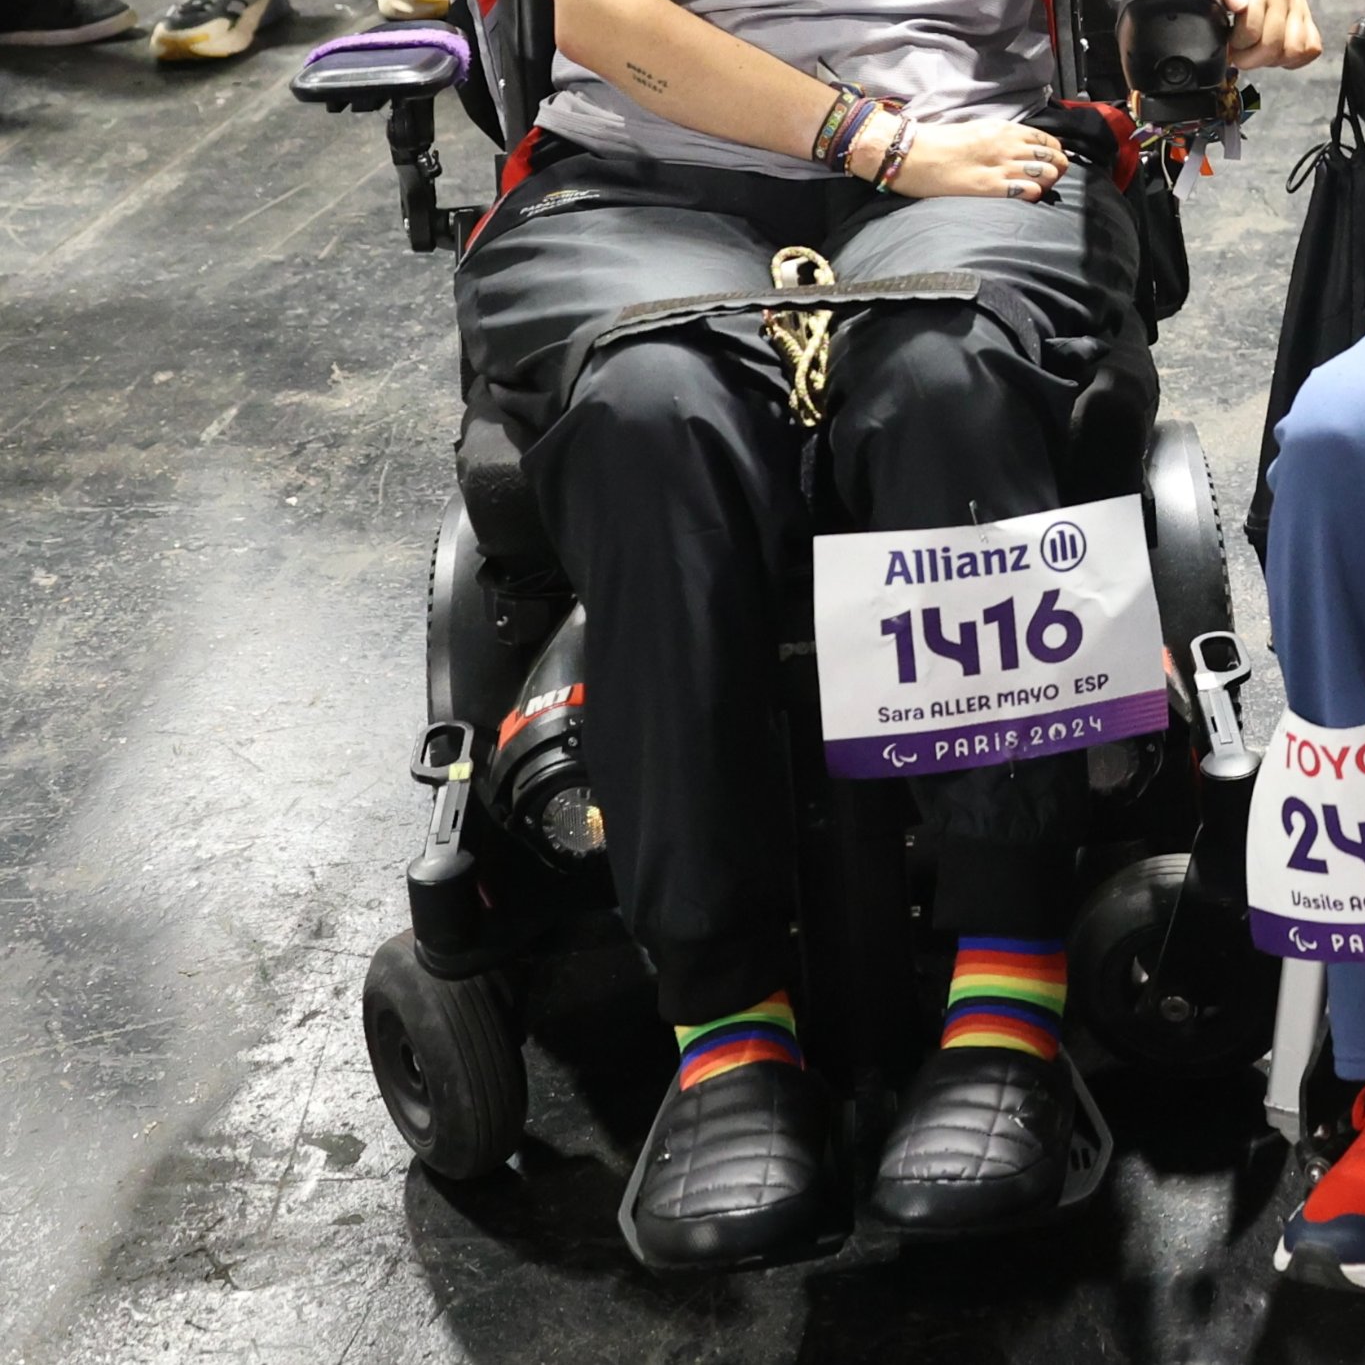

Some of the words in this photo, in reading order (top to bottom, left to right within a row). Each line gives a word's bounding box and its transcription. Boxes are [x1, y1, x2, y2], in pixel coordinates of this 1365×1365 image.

[884, 543, 1031, 586] Allianz
[880, 588, 1083, 684] 1416
[878, 706, 924, 723] Sara
[930, 695, 991, 718] ALLER
[997, 684, 1060, 708] MAYO
[1074, 673, 1109, 695] ESP
[1030, 717, 1103, 743] 2024
[1290, 889, 1344, 911] Vasile
